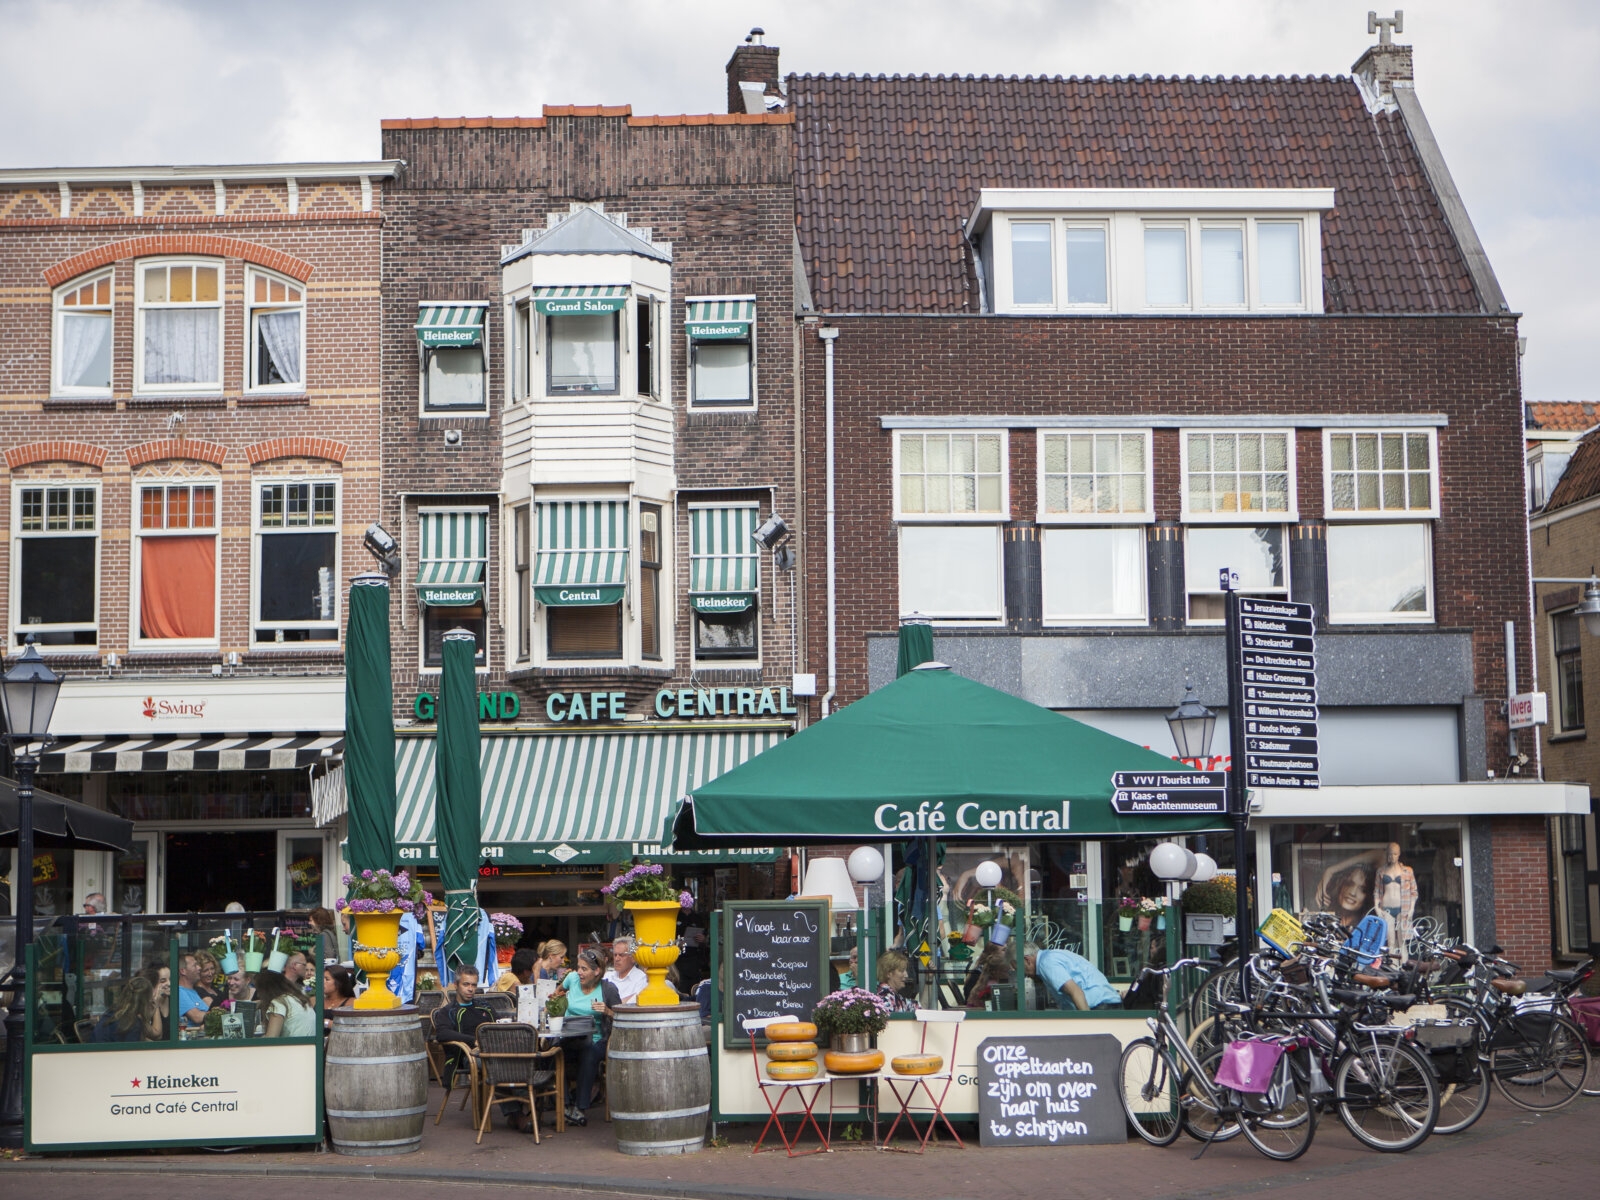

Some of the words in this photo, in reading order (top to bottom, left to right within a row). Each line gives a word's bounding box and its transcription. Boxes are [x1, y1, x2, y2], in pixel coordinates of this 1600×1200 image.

[546, 301, 581, 312] Grand
[584, 301, 614, 312] Salon
[424, 330, 473, 340] Heineken
[692, 326, 742, 335] Heineken
[425, 590, 476, 601] Heineken
[559, 589, 600, 602] Central
[696, 597, 747, 608] Heineken
[1254, 621, 1287, 631] Bibliotheek
[1255, 638, 1293, 648] Streekarchief
[1256, 656, 1263, 664] De
[1298, 659, 1310, 667] Dom
[1256, 672, 1272, 681] Huize
[159, 700, 203, 718] Swing
[414, 692, 520, 720] GND
[546, 692, 627, 722] CAFE
[655, 687, 797, 718] CENTRAL
[1510, 698, 1532, 716] livera
[1258, 706, 1278, 716] Willem
[1259, 724, 1279, 733] Joodse
[1280, 725, 1301, 736] Poortje
[1259, 741, 1290, 750] Stadsmuur
[1132, 776, 1154, 784] VVV
[1161, 776, 1191, 784] Tourist
[1193, 776, 1210, 784] Info
[1260, 776, 1275, 784] Klein
[1276, 777, 1300, 786] Amerika
[1132, 792, 1155, 800] Kaas-
[1132, 802, 1218, 810] Ambachtenmuseum
[874, 801, 946, 832] Café
[956, 800, 1070, 830] Central
[745, 916, 775, 935] Vraagt
[782, 922, 791, 931] u
[740, 949, 769, 960] Broodjes
[777, 958, 808, 970] Soepen
[744, 970, 786, 982] Dagschotels
[782, 999, 804, 1008] Bieren
[754, 1009, 780, 1017] Desserts
[994, 1058, 1093, 1078] appeltaarten
[147, 1074, 219, 1089] Heineken
[1026, 1081, 1052, 1098] om
[1057, 1081, 1098, 1099] over
[110, 1104, 151, 1116] Grand
[156, 1101, 187, 1114] Café
[191, 1100, 238, 1112] Central
[1000, 1100, 1039, 1118] naar
[1046, 1097, 1080, 1114] huis
[990, 1120, 1011, 1137] te
[1015, 1118, 1088, 1142] schrijven
